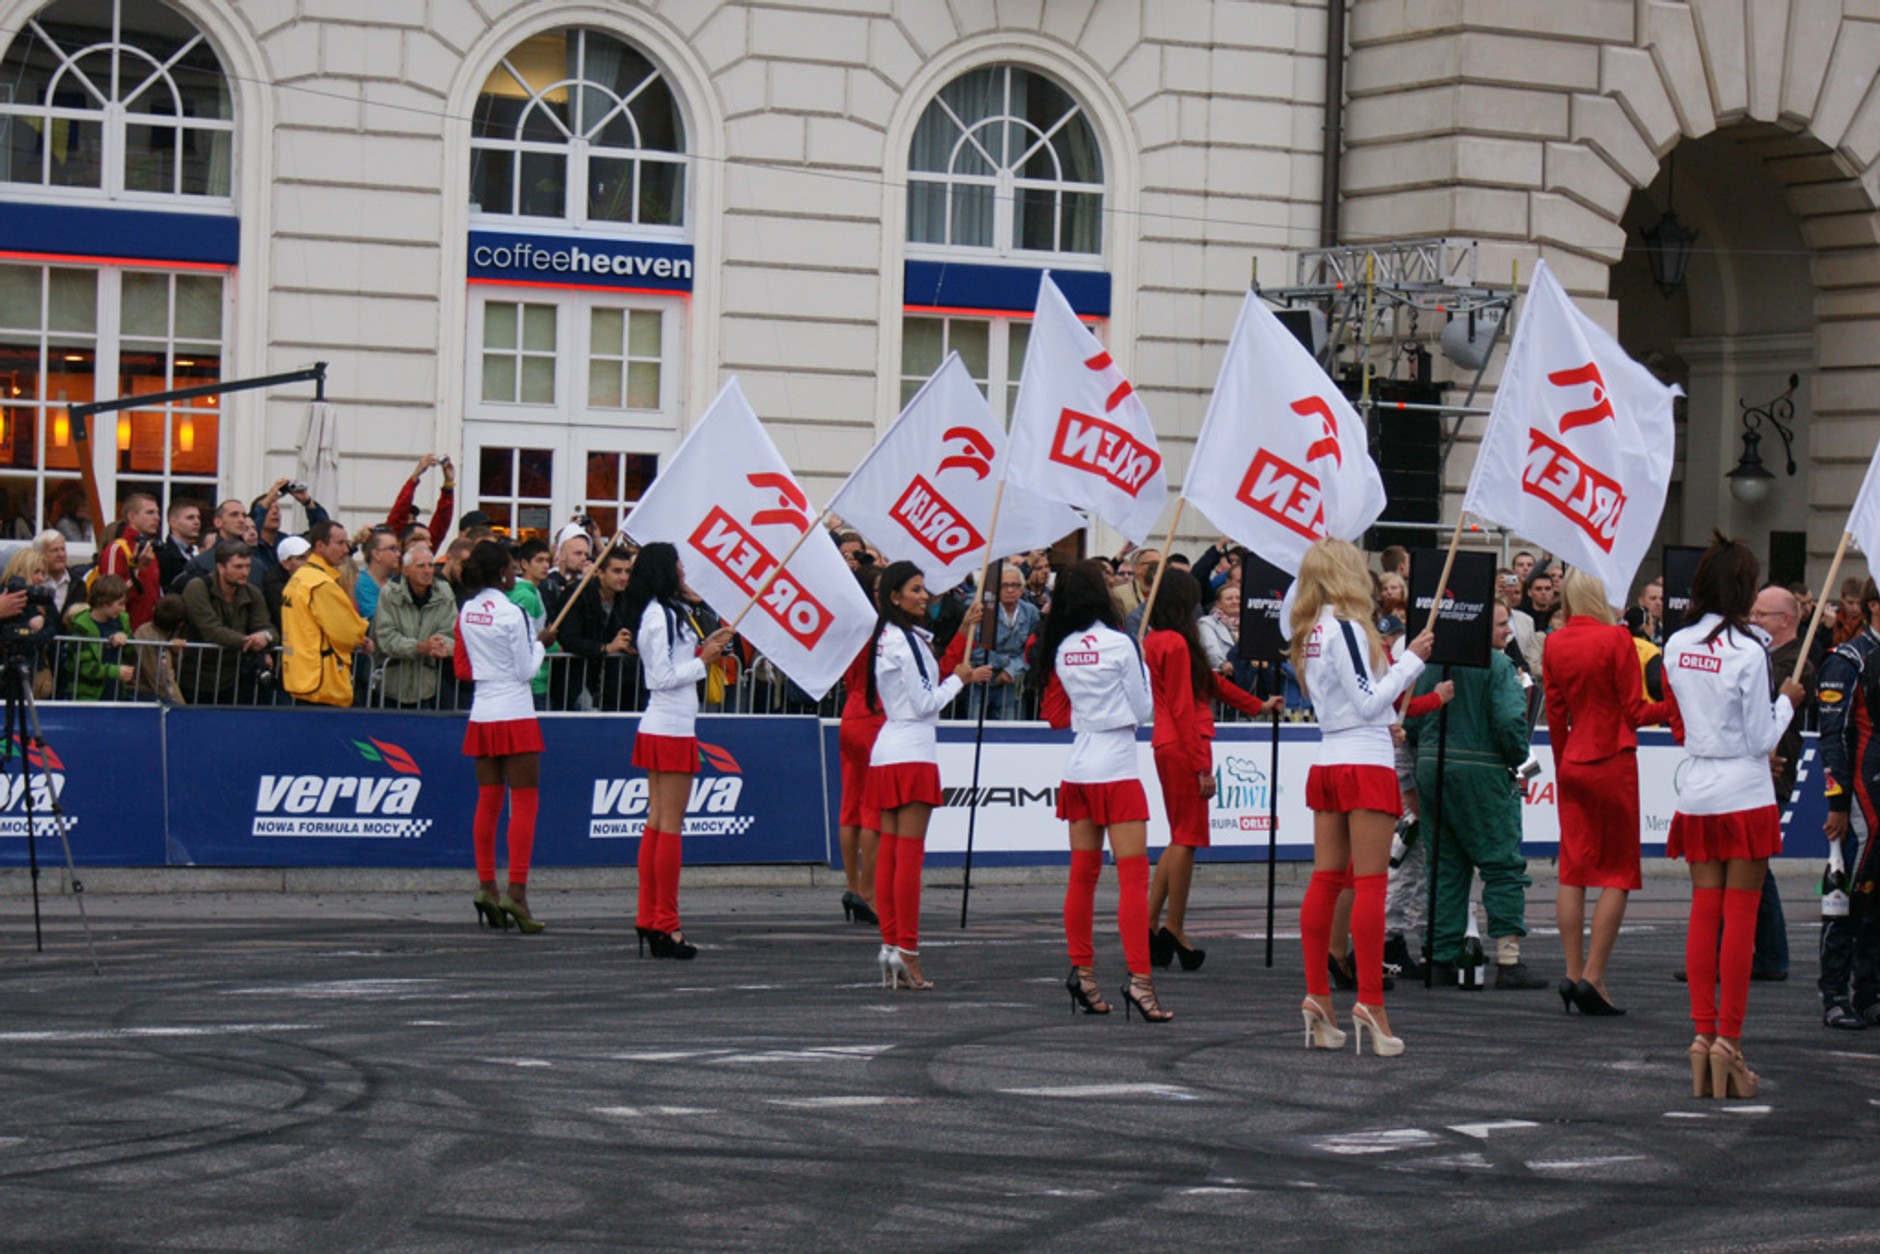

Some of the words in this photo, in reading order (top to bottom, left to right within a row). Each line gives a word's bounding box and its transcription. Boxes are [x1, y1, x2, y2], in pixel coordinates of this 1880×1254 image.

[474, 243, 692, 278] coffeeheaven
[1066, 653, 1097, 664] ORLEN
[1681, 655, 1719, 671] ORLEN
[256, 775, 422, 814] verva
[591, 776, 743, 815] veva
[980, 787, 1060, 807] AM
[256, 821, 295, 833] NOWA
[298, 822, 360, 834] FORMUŁA
[363, 823, 400, 834] MOCY
[593, 823, 628, 834] NOWA
[690, 821, 725, 832] MOCY
[1211, 818, 1239, 829] RUPA
[1241, 818, 1272, 829] ORLE
[1645, 815, 1670, 831] Mer
